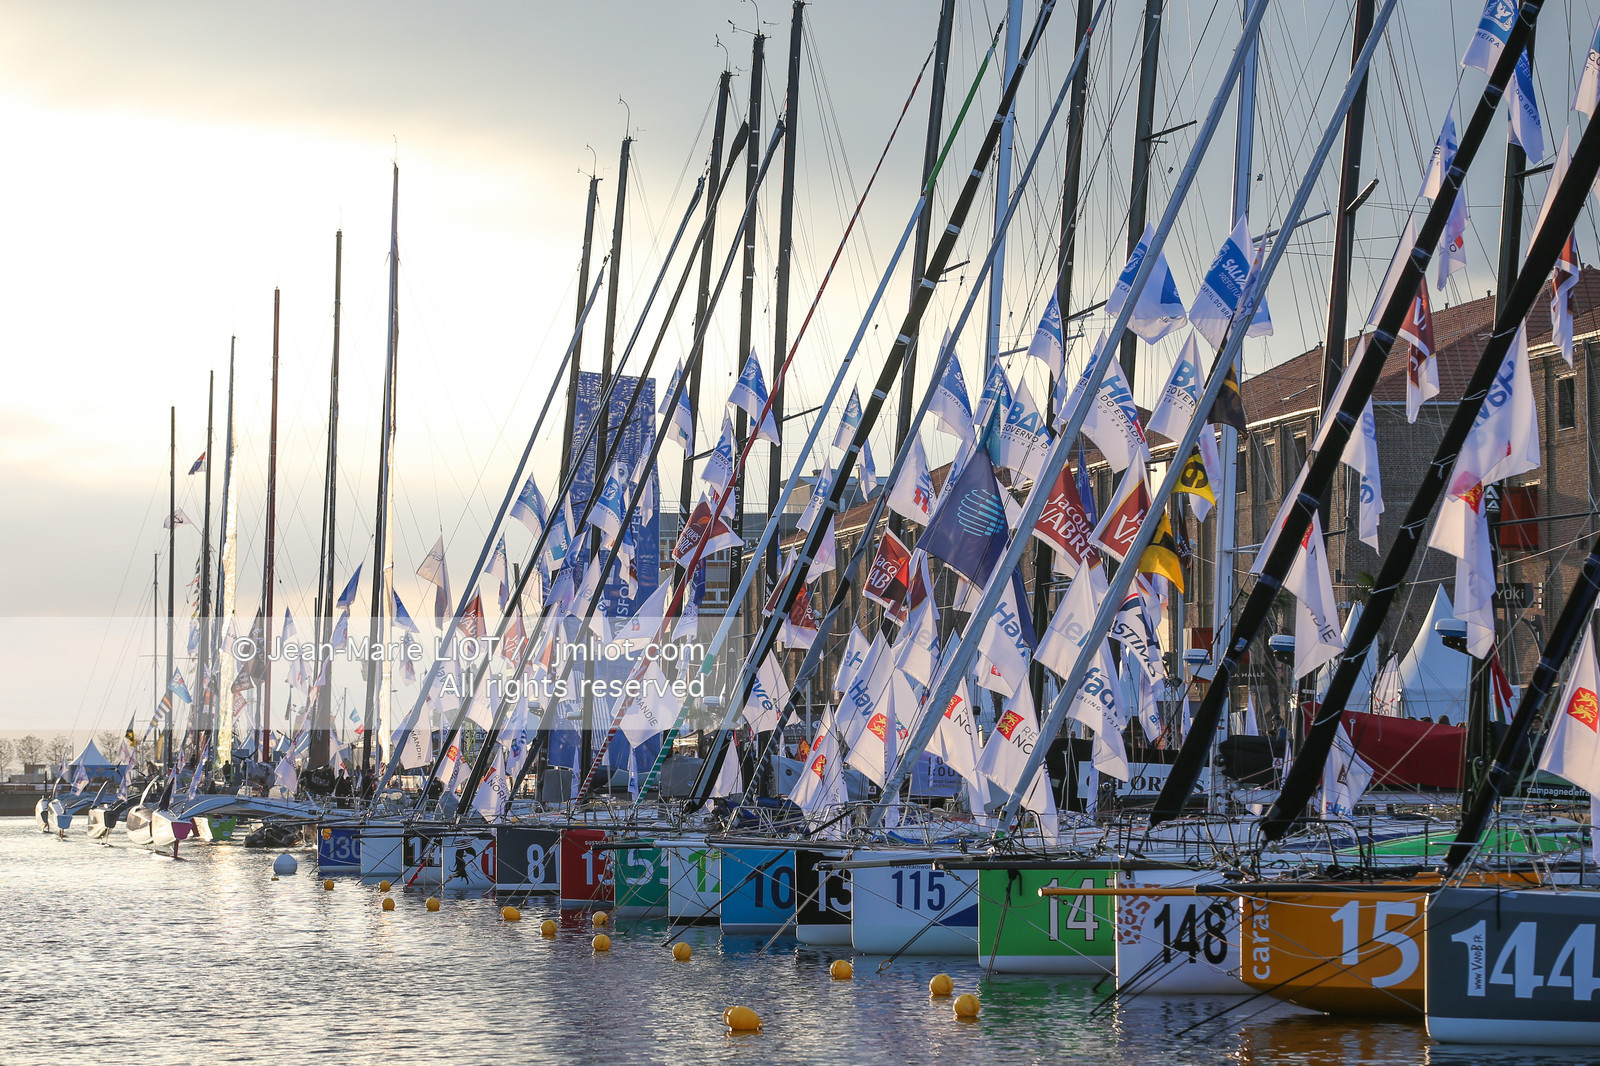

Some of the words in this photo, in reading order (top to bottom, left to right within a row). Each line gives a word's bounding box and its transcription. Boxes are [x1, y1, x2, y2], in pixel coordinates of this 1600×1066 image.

[1218, 272, 1242, 298] PREFEITU
[1214, 299, 1222, 308] DO
[1220, 307, 1231, 320] BRA
[940, 388, 962, 409] CAPITAL
[1100, 394, 1114, 408] DO
[1114, 408, 1144, 445] ESTADO
[754, 866, 795, 908] 10
[892, 870, 946, 911] 115
[1154, 904, 1228, 964] 148
[1330, 900, 1420, 988] 15
